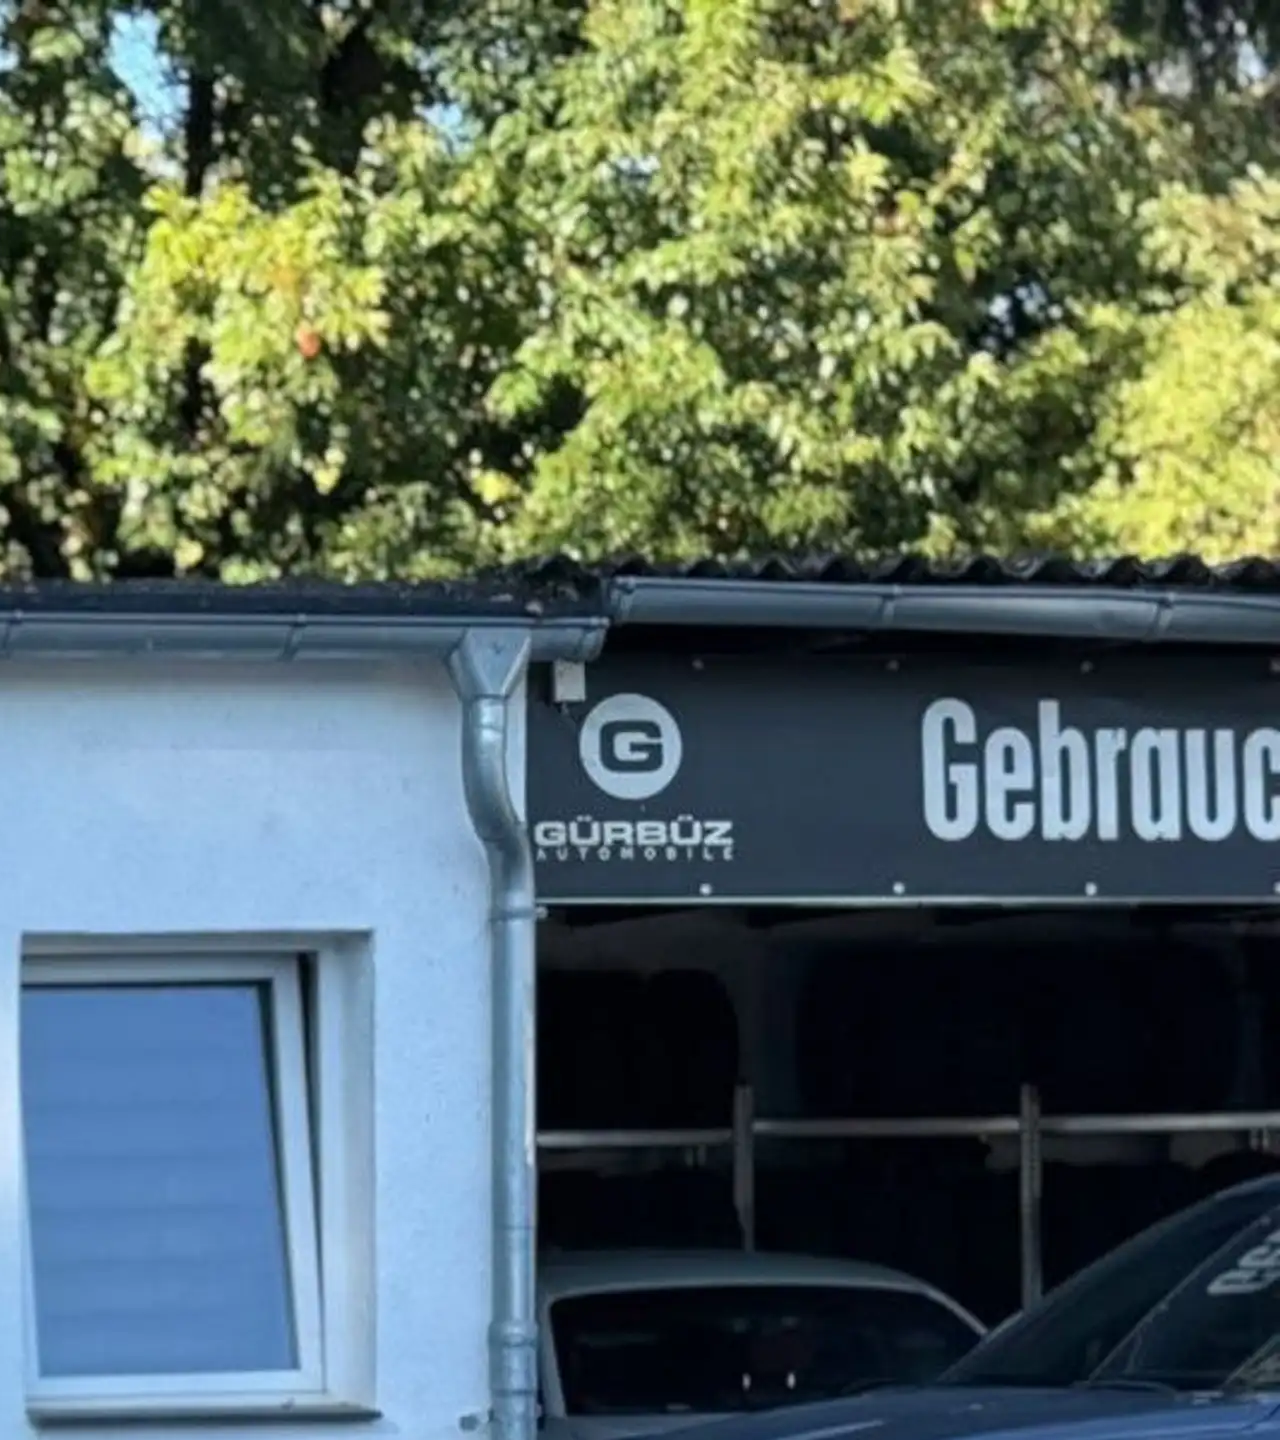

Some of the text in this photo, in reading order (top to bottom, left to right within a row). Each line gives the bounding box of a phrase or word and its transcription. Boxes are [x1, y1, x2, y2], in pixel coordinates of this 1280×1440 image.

[921, 697, 1280, 841] Gebrauc
[534, 814, 734, 846] GÜRBÜZ
[536, 847, 734, 861] AUTOMOBILE
